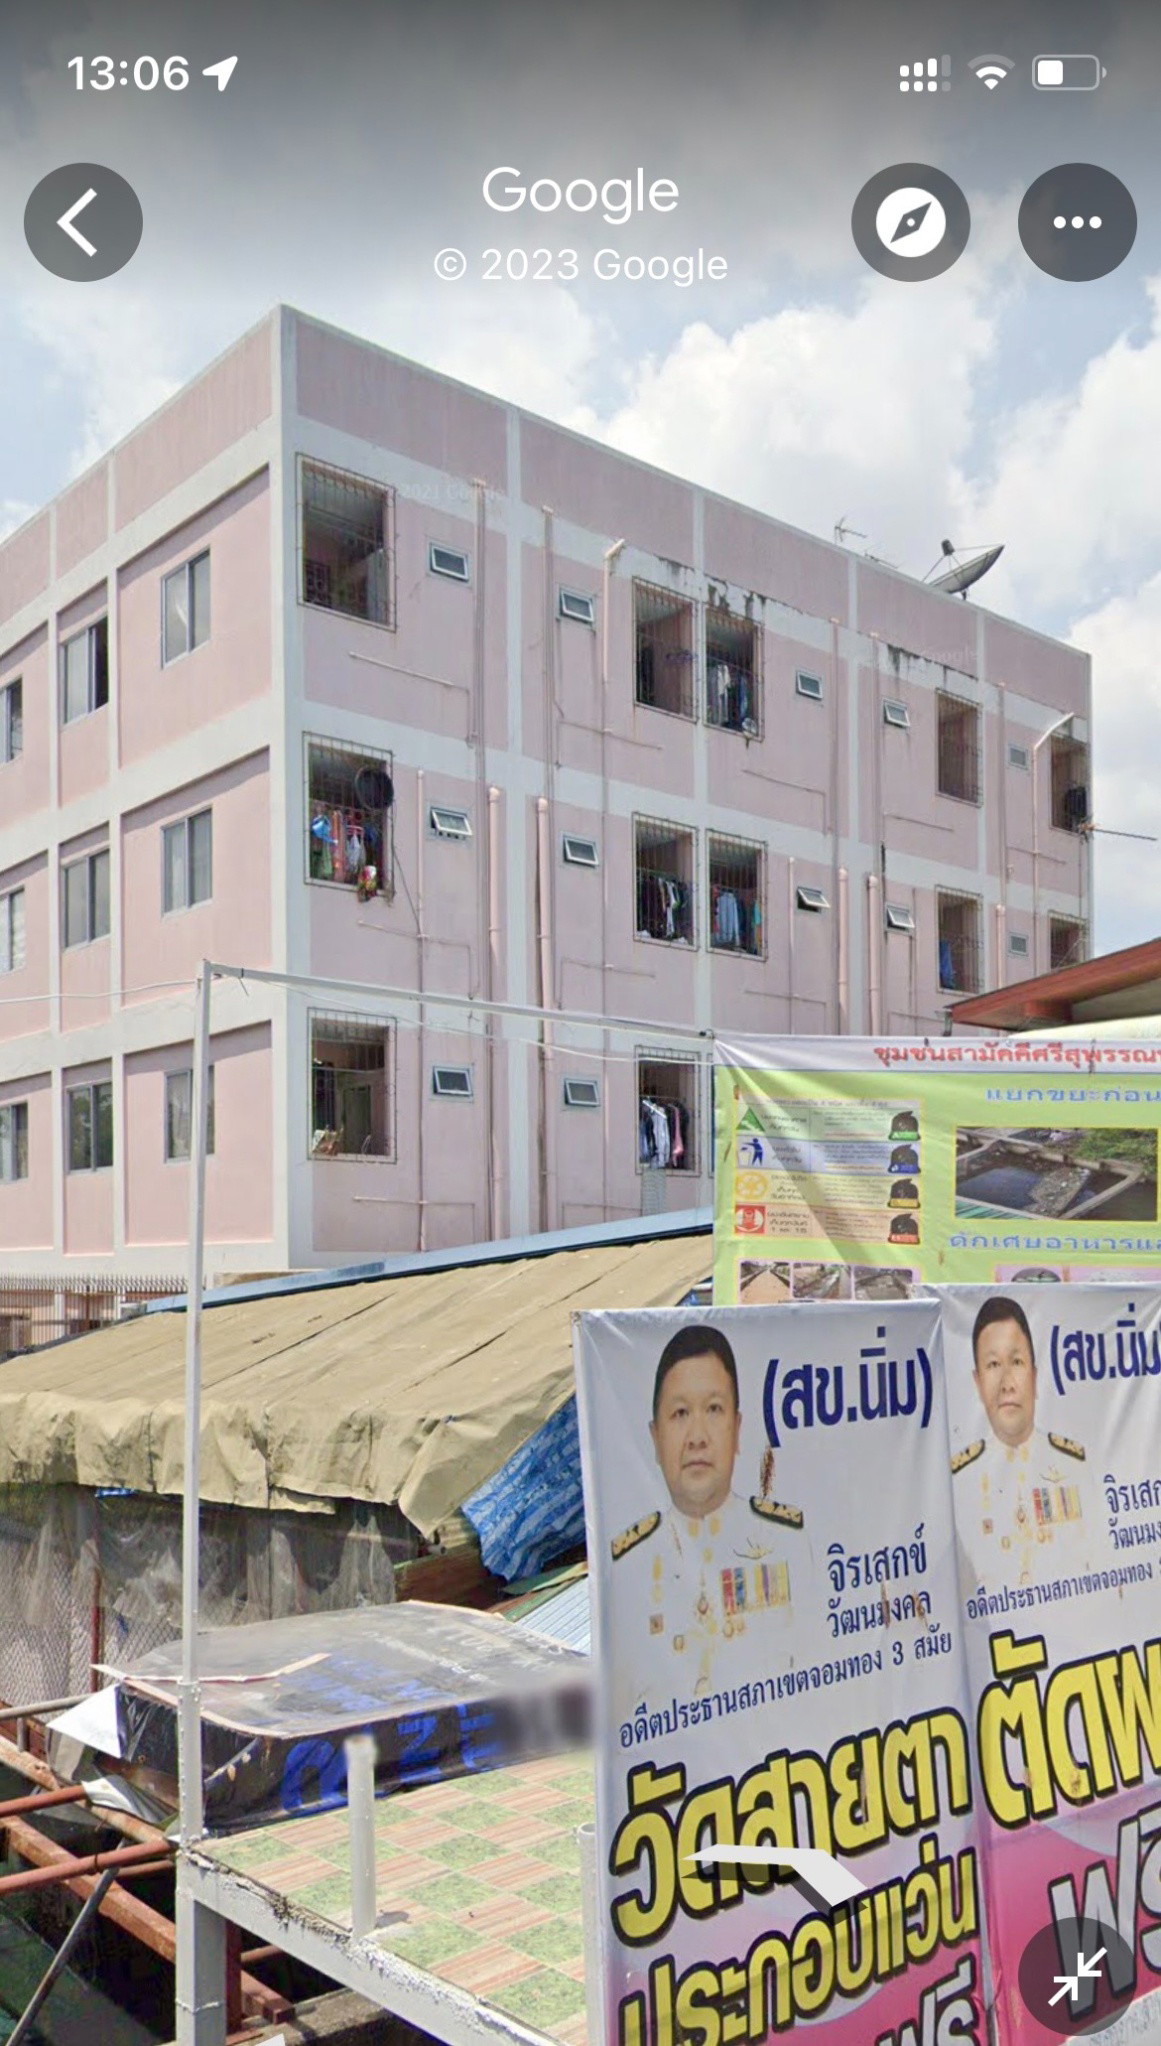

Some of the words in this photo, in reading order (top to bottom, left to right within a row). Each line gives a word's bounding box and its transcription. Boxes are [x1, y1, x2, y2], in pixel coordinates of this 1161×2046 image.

[874, 1041, 1161, 1069] ชุมชนสามัคคีศรีสุพรรณ
[763, 1326, 933, 1448] (สข.นิ่ม)
[1050, 1303, 1161, 1396] (สข.นิ่ม
[826, 1522, 928, 1592] จิรเสกข์
[619, 1650, 883, 1749] อดีตประธานสภาเขตจอมทอง
[893, 1641, 904, 1667] 3
[913, 1622, 953, 1660] สมัย
[608, 1706, 975, 1945] วัดสายตา
